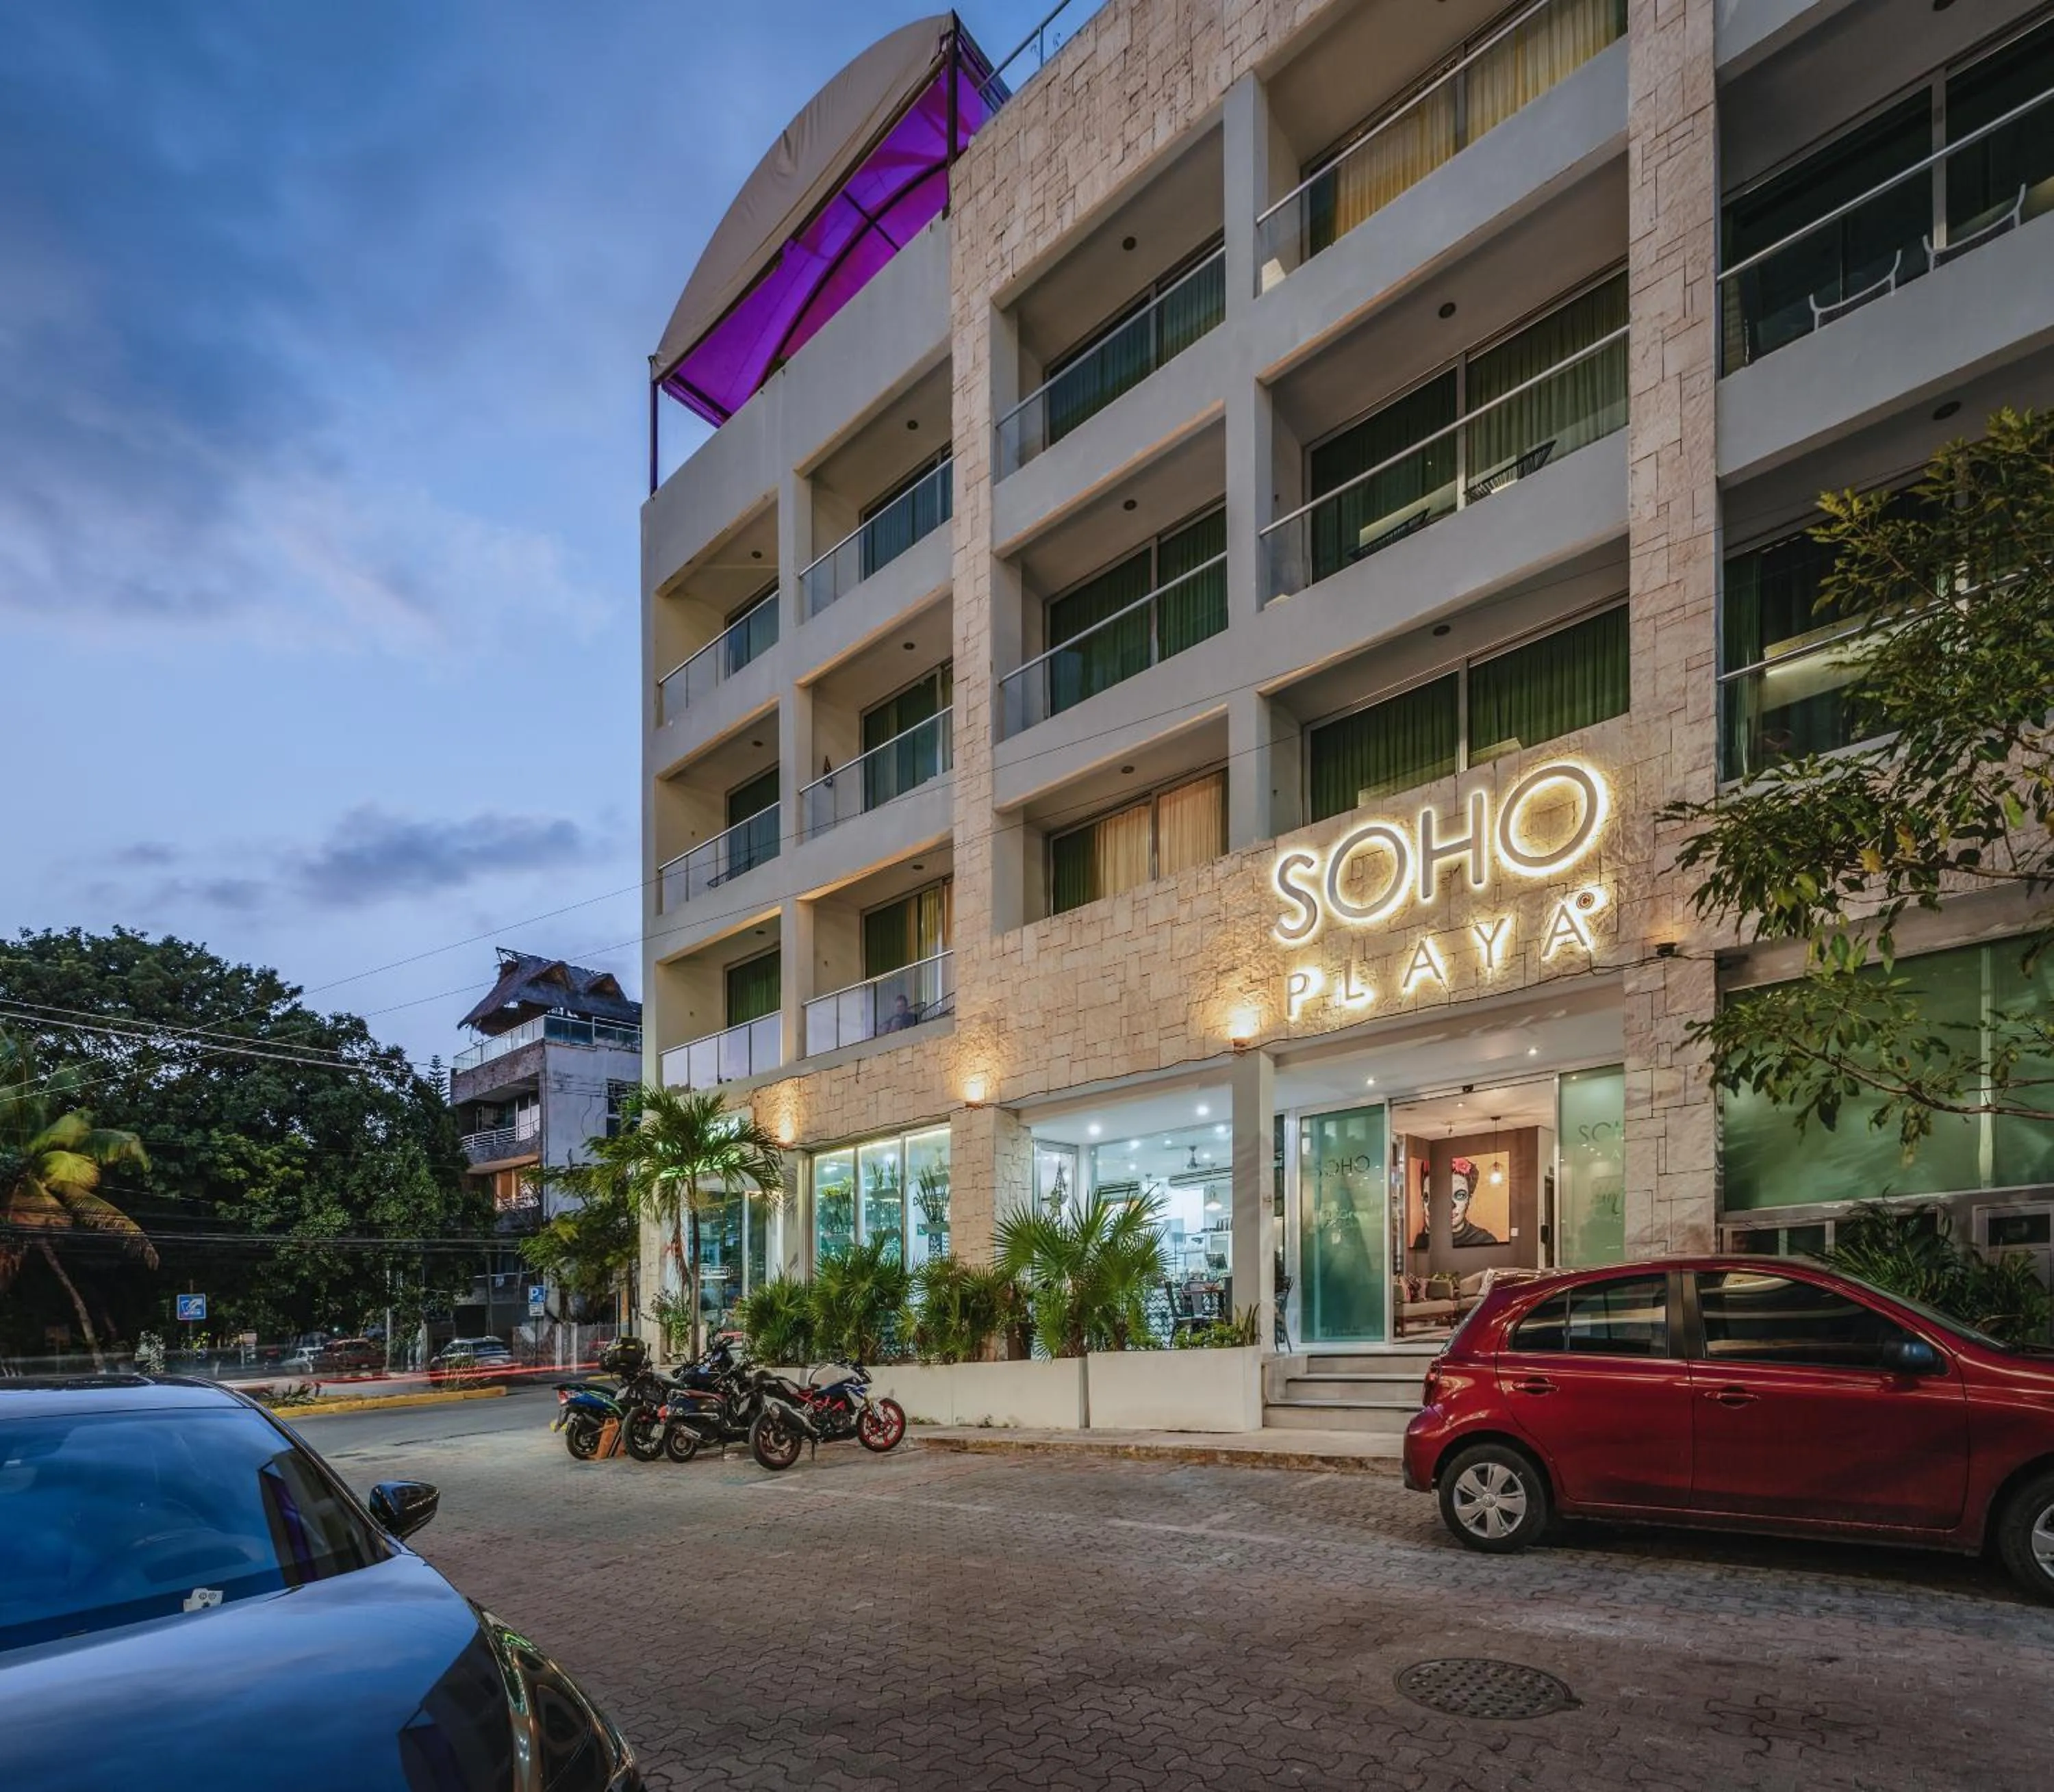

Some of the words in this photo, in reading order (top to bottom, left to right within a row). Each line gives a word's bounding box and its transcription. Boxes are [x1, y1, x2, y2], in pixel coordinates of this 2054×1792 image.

[1276, 764, 1599, 940] SOHO
[1286, 903, 1590, 1018] PLAYA
[531, 1288, 539, 1300] P
